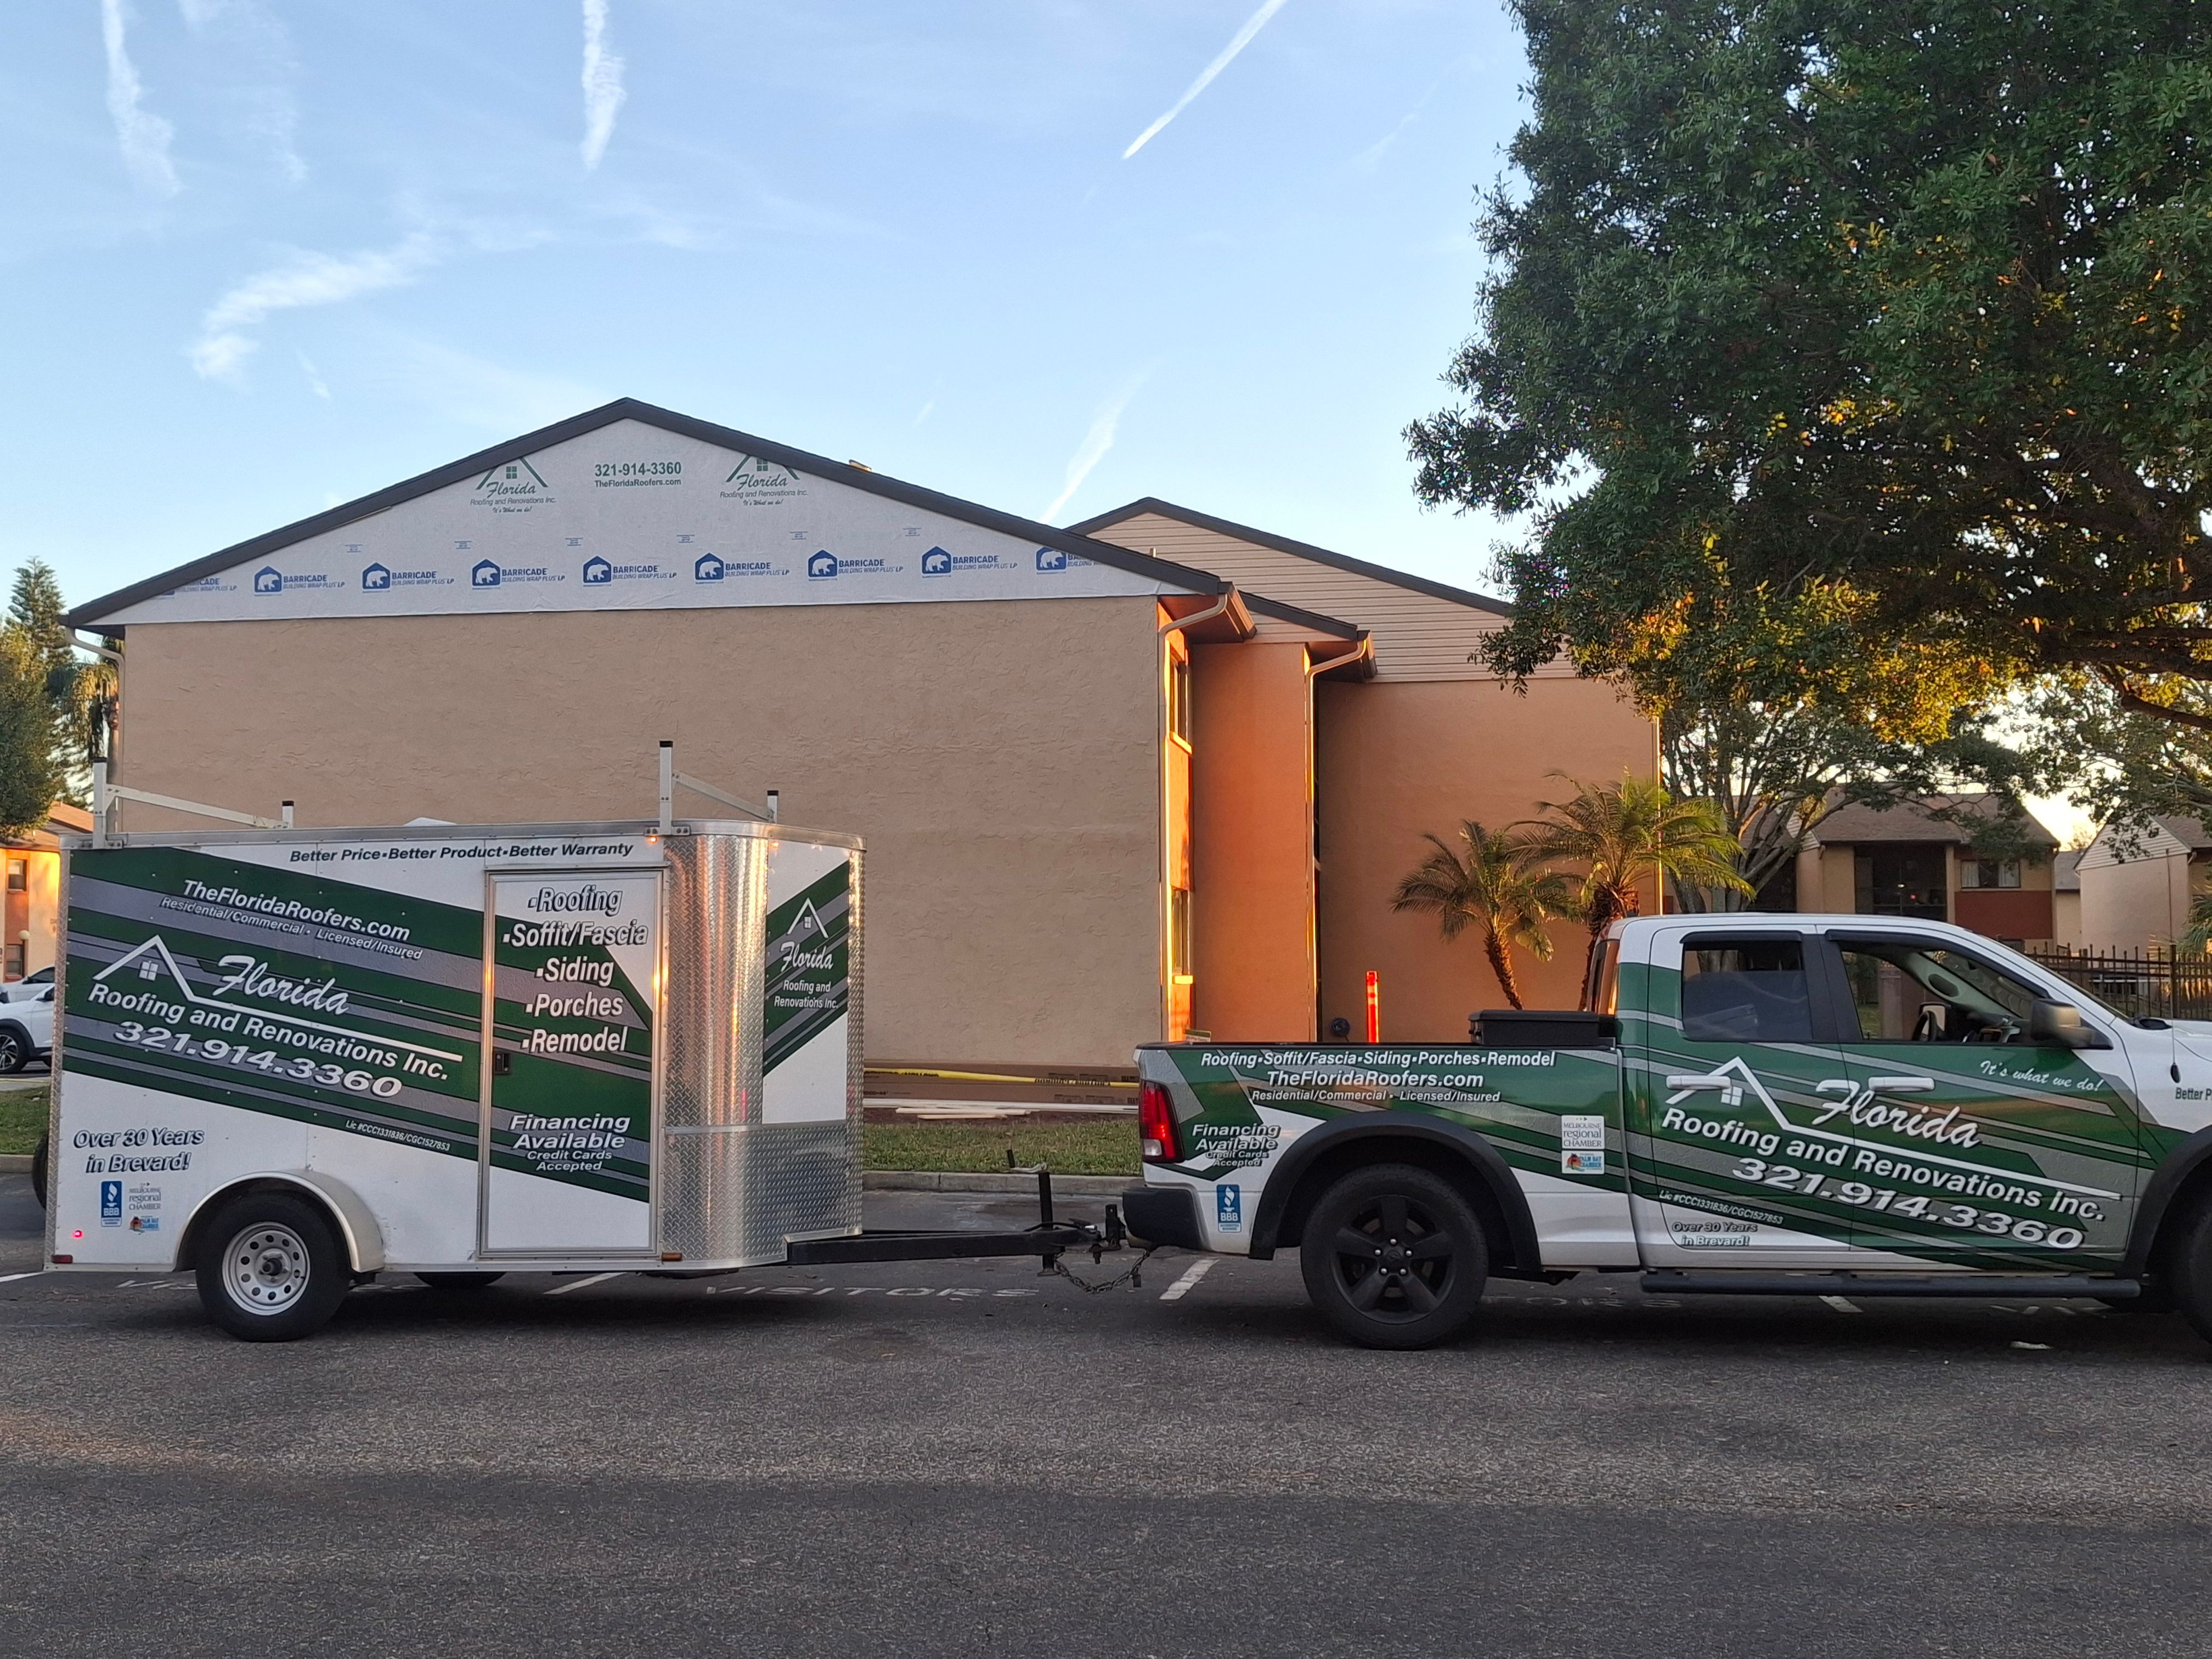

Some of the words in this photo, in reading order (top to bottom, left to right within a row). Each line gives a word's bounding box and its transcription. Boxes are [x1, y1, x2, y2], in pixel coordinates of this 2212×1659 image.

[594, 461, 682, 477] 321-914-3360
[486, 481, 537, 498] Florida
[594, 478, 682, 487] TheFloridaRoofers.com
[736, 473, 788, 491] Florida
[839, 558, 885, 567] BARRICADE
[953, 555, 999, 563] BARRICADE
[392, 571, 437, 579] BARRICADE
[501, 568, 547, 576] BARRICADE
[290, 850, 337, 862] Better
[562, 843, 634, 856] Warranty
[535, 884, 623, 917] Roofing
[183, 879, 410, 942] TheFloridaRoofers.com
[161, 897, 305, 935] Residential/Commercial
[315, 928, 424, 961] Licensed/Insured
[510, 919, 649, 947] Soffit/Fascia
[780, 941, 834, 973] Florida
[544, 955, 615, 988] Siding
[212, 955, 351, 1016] Florida
[783, 979, 814, 994] Roofing
[816, 981, 831, 992] and
[533, 991, 624, 1018] Porches
[774, 996, 823, 1008] Renovations
[824, 997, 839, 1009] Inc.
[87, 983, 185, 1024] Roofing
[189, 1008, 240, 1033] and
[244, 1018, 398, 1069] Renovations
[401, 1052, 449, 1081] Inc.
[529, 1026, 629, 1053] Remodel
[114, 1020, 404, 1098] 321.914.3360
[1267, 1070, 1484, 1088] TheFloridaRoofers.com
[1979, 1060, 2008, 1077] It's
[2012, 1068, 2050, 1085] what
[2052, 1076, 2073, 1088] we
[2076, 1078, 2105, 1092] do!
[1251, 1090, 1387, 1101] Residential/Commercial
[1400, 1090, 1502, 1103] Licensed/Insured
[2175, 1087, 2204, 1101] Better
[1812, 1079, 1983, 1150] Florida
[345, 1120, 357, 1130] Lic
[508, 1113, 631, 1133] Financing
[1192, 1123, 1282, 1138] Financing
[73, 1129, 121, 1148] Over
[122, 1128, 149, 1147] 30
[151, 1127, 205, 1146] Years
[511, 1132, 626, 1150] Available
[1564, 1128, 1601, 1140] regional
[1195, 1137, 1279, 1151] Available
[86, 1154, 106, 1173] in
[108, 1152, 192, 1173] Brevard!
[526, 1150, 569, 1160] Credit
[572, 1150, 613, 1160] Cards
[1205, 1151, 1236, 1159] Credit
[535, 1161, 603, 1173] Accepted
[1213, 1159, 1263, 1168] Accepted
[1661, 1107, 1780, 1158] Roofing
[1786, 1136, 1848, 1168] and
[1852, 1148, 2040, 1207] Renovations
[2048, 1188, 2108, 1222] Inc.
[1659, 1189, 1673, 1200] Lic
[103, 1207, 120, 1216] BBB
[1731, 1156, 2085, 1251] 321.914.3360
[1220, 1212, 1239, 1221] BBB
[1672, 1222, 1703, 1232] Over
[1703, 1222, 1721, 1232] 30
[1724, 1222, 1758, 1232] Years
[1681, 1235, 1696, 1246] in
[1696, 1235, 1751, 1246] Brevard!
[706, 1286, 1040, 1297] VISITORS
